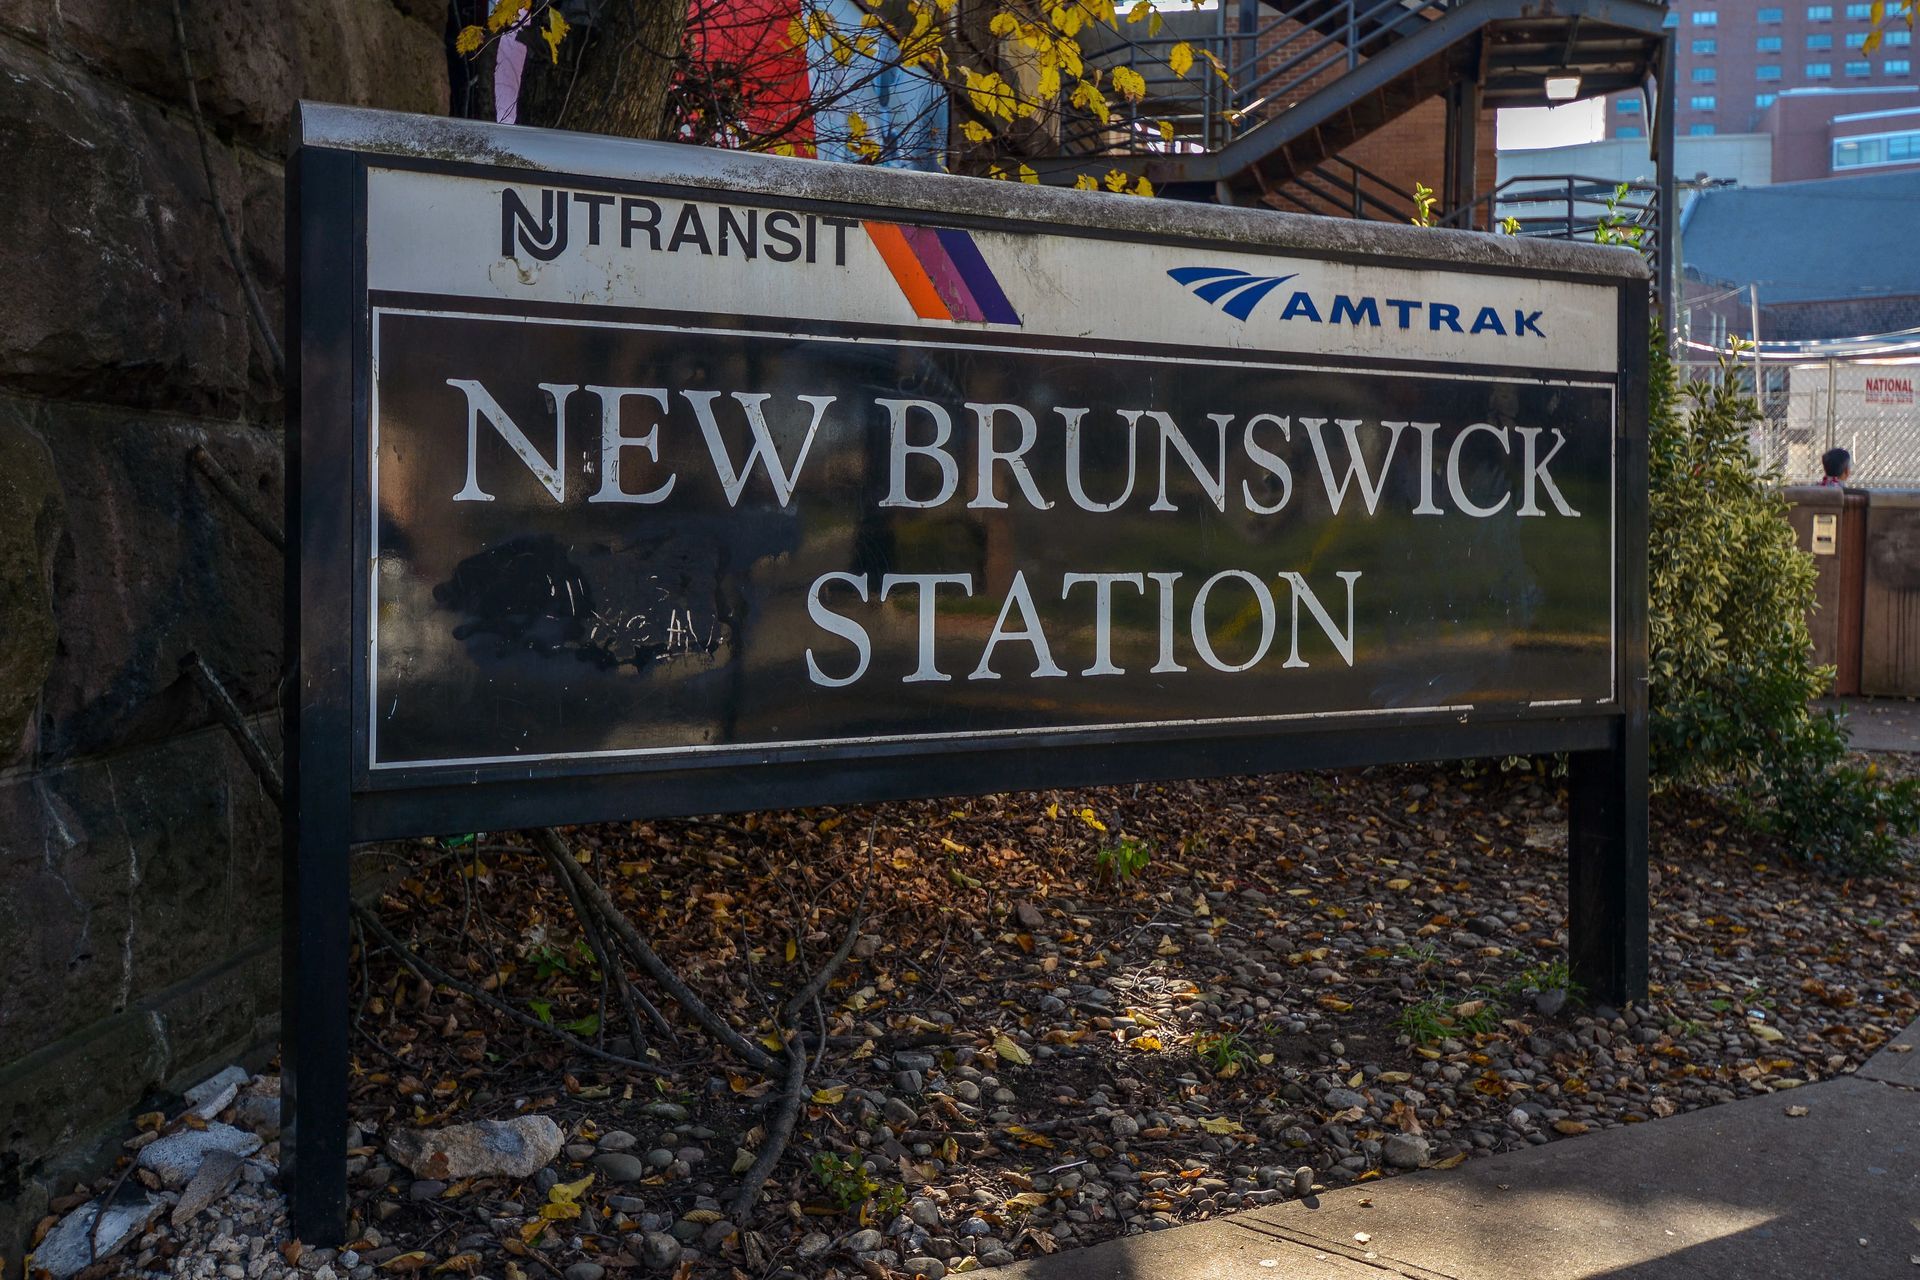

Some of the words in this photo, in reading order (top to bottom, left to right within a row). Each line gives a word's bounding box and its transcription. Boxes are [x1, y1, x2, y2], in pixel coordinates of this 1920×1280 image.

[1280, 291, 1547, 338] AMTRAK
[1866, 377, 1913, 392] NATIONAL
[446, 378, 838, 508] NEW
[875, 397, 1583, 518] BRUNSWICK
[805, 569, 1363, 688] STATION
